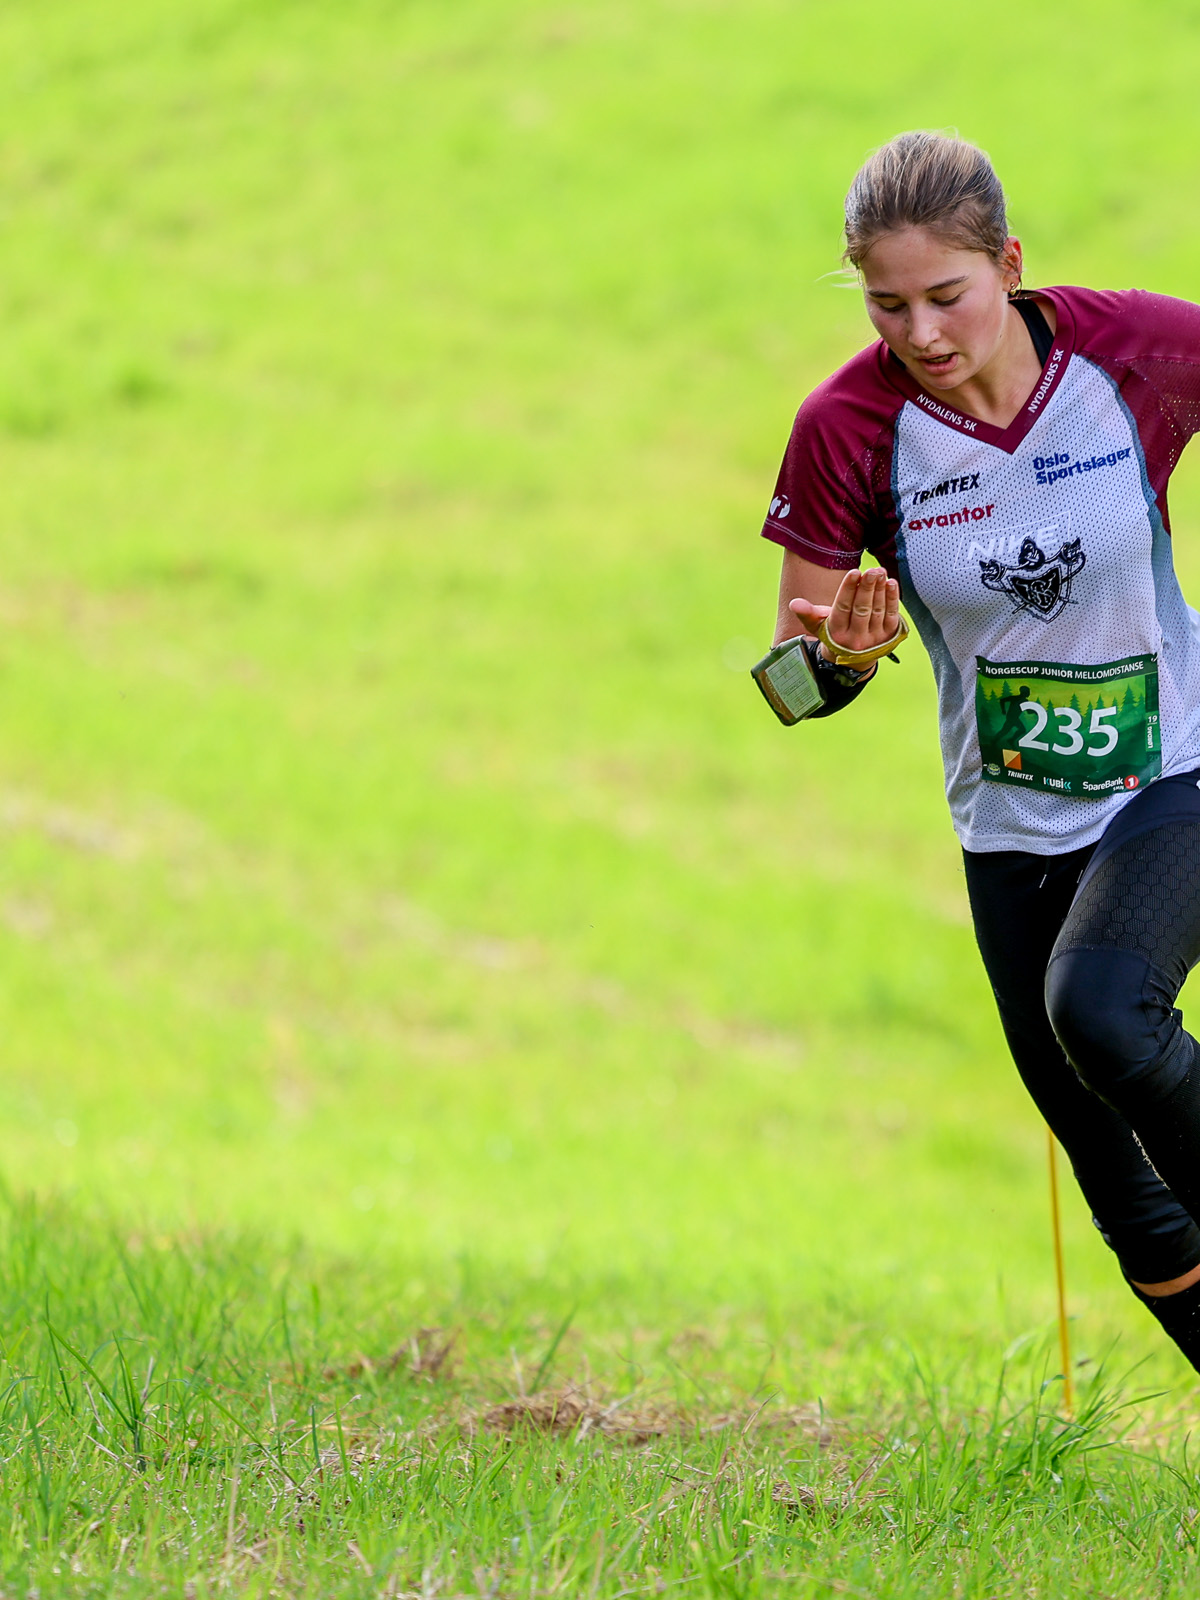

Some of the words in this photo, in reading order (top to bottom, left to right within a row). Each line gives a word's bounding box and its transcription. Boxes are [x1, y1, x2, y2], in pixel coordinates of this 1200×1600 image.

[1028, 362, 1058, 413] NYDALENS
[1053, 349, 1064, 362] SK
[916, 393, 963, 426] NYDALENS
[963, 419, 977, 432] SK
[1033, 452, 1070, 471] Oslo
[1036, 447, 1132, 485] Sportslager
[912, 472, 980, 505] TRIMTEX
[908, 503, 995, 531] avantor
[966, 524, 1059, 560] NIKE
[985, 665, 1039, 675] NORGESCUP
[1041, 668, 1073, 679] JUNIOR
[1074, 660, 1144, 679] MELLOMDISTANSE
[1018, 701, 1119, 757] 235
[1147, 715, 1158, 723] 19
[1007, 770, 1034, 781] TRIMTEX
[1082, 776, 1124, 792] SpareBank
